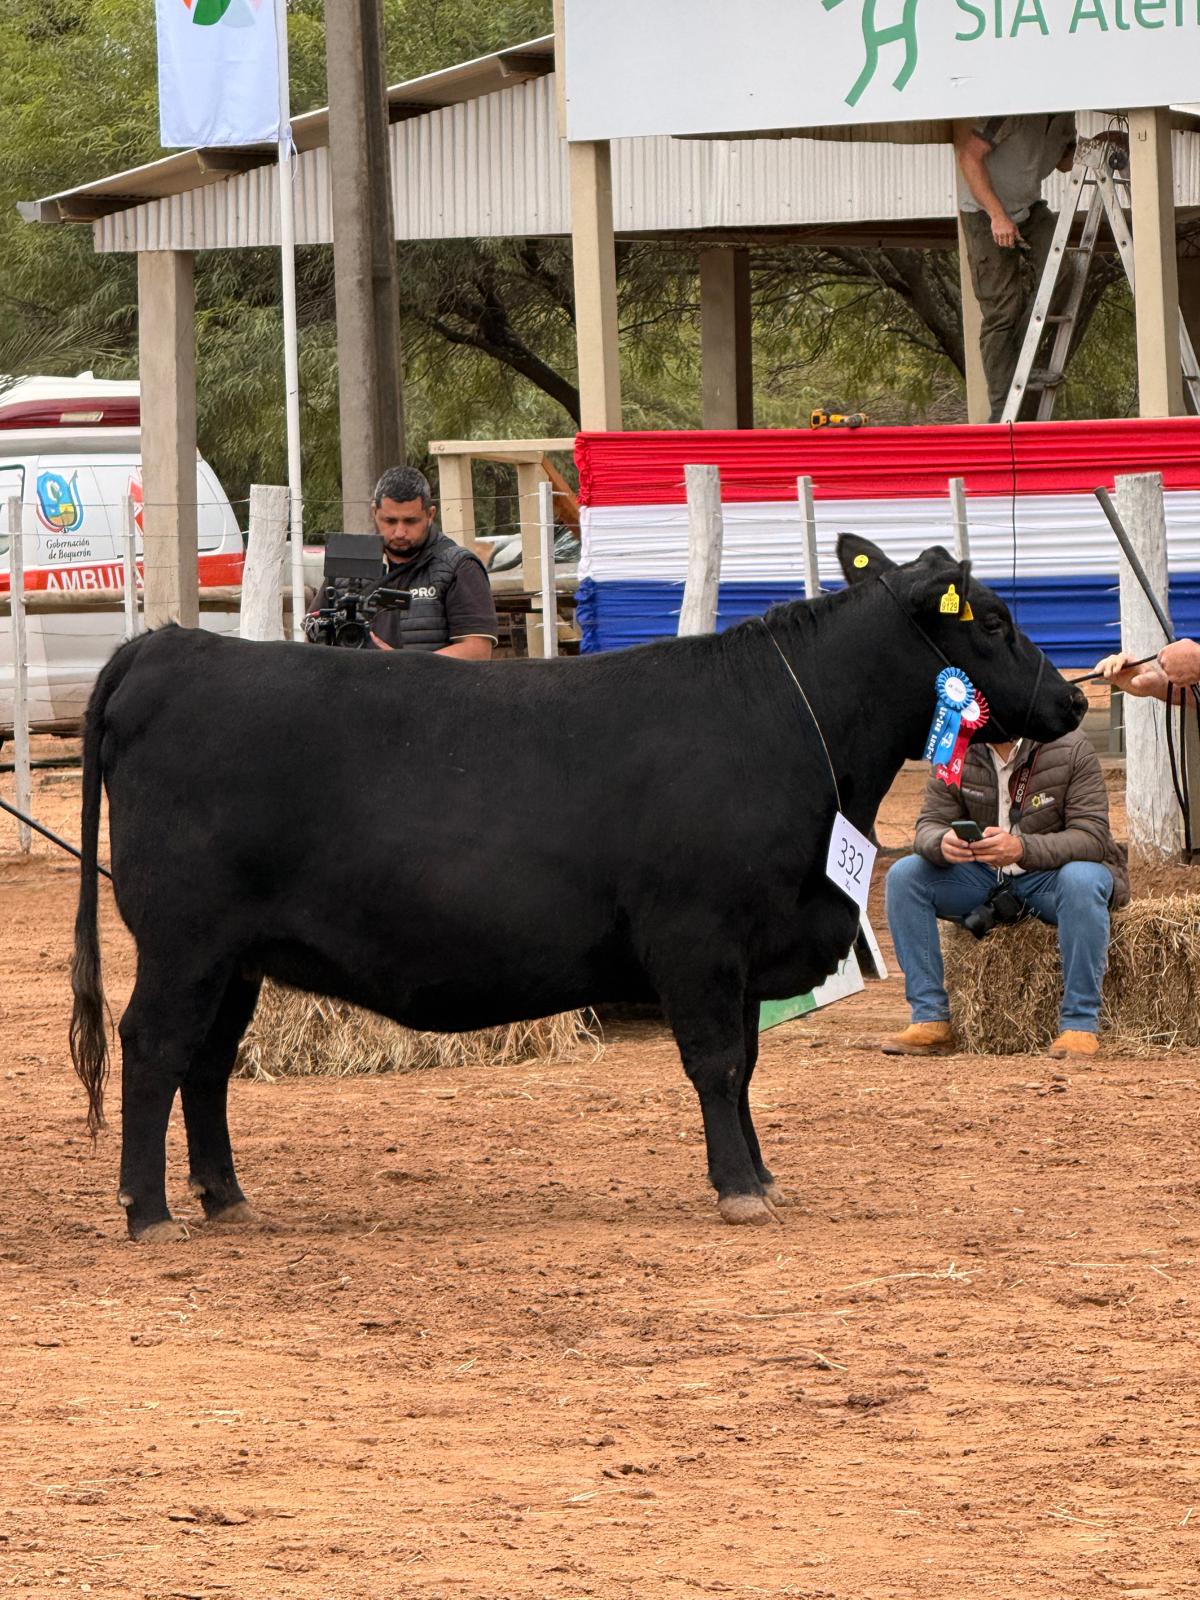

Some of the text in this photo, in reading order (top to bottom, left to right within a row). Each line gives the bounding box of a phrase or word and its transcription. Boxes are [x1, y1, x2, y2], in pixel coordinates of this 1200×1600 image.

[46, 538, 90, 549] Gobernación
[48, 547, 92, 562] de Boquerón
[941, 601, 958, 612] 9129
[1015, 782, 1026, 803] EOS
[837, 837, 864, 885] 332
